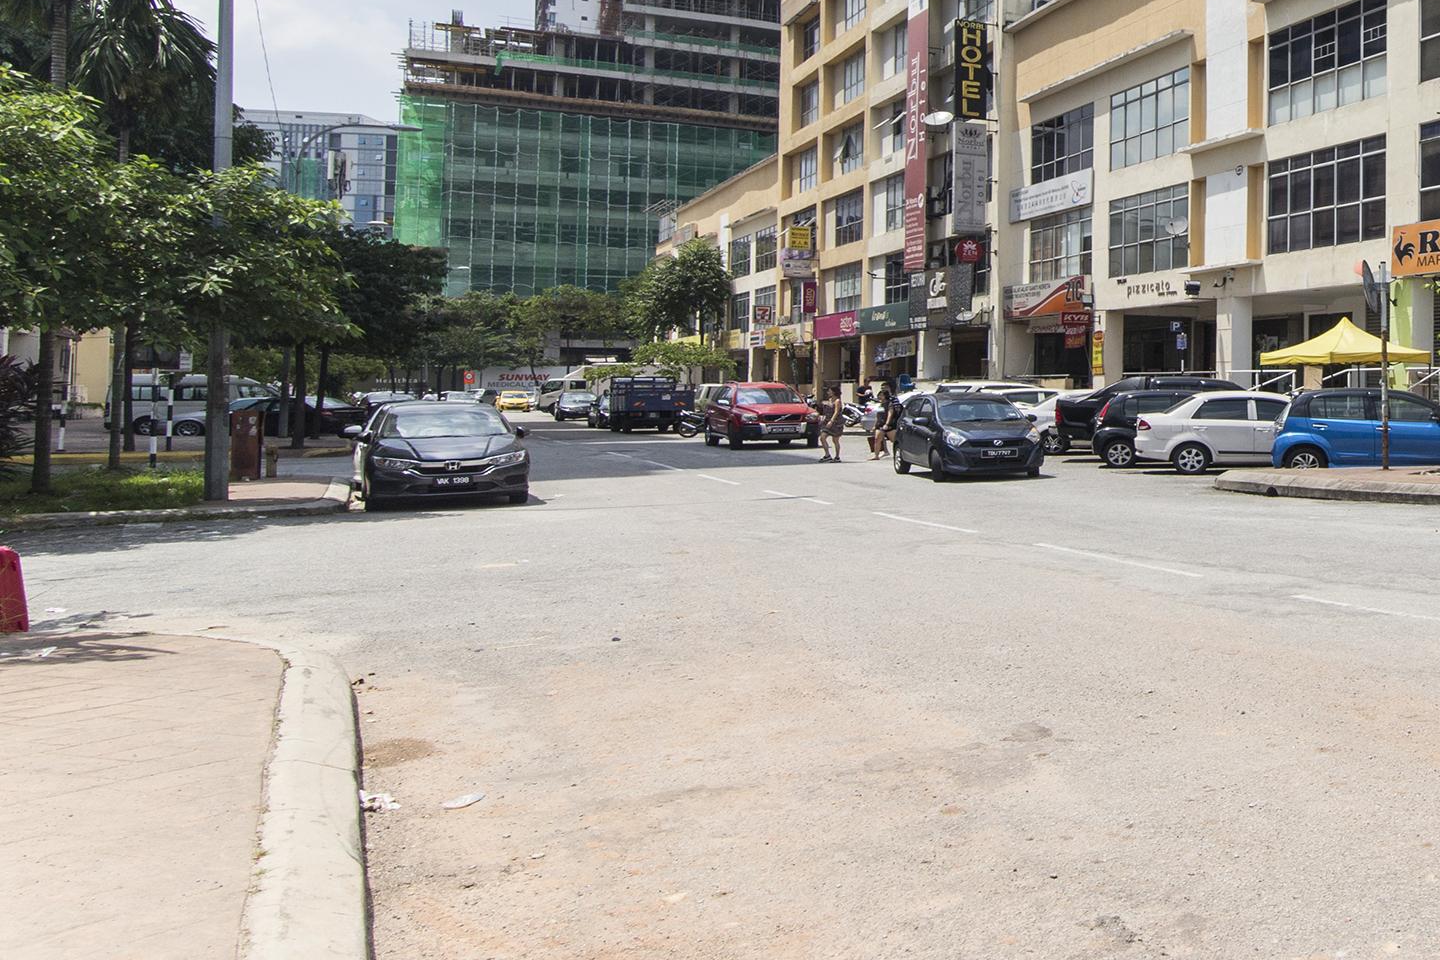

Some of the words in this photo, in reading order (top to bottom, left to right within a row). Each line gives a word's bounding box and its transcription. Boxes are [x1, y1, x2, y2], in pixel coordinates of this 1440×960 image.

[956, 20, 986, 30] NORBU
[960, 28, 982, 117] HOTEL
[1126, 279, 1171, 299] pizzicato
[1062, 313, 1090, 321] KYB
[1172, 321, 1181, 331] P
[499, 373, 551, 381] SUNWAY
